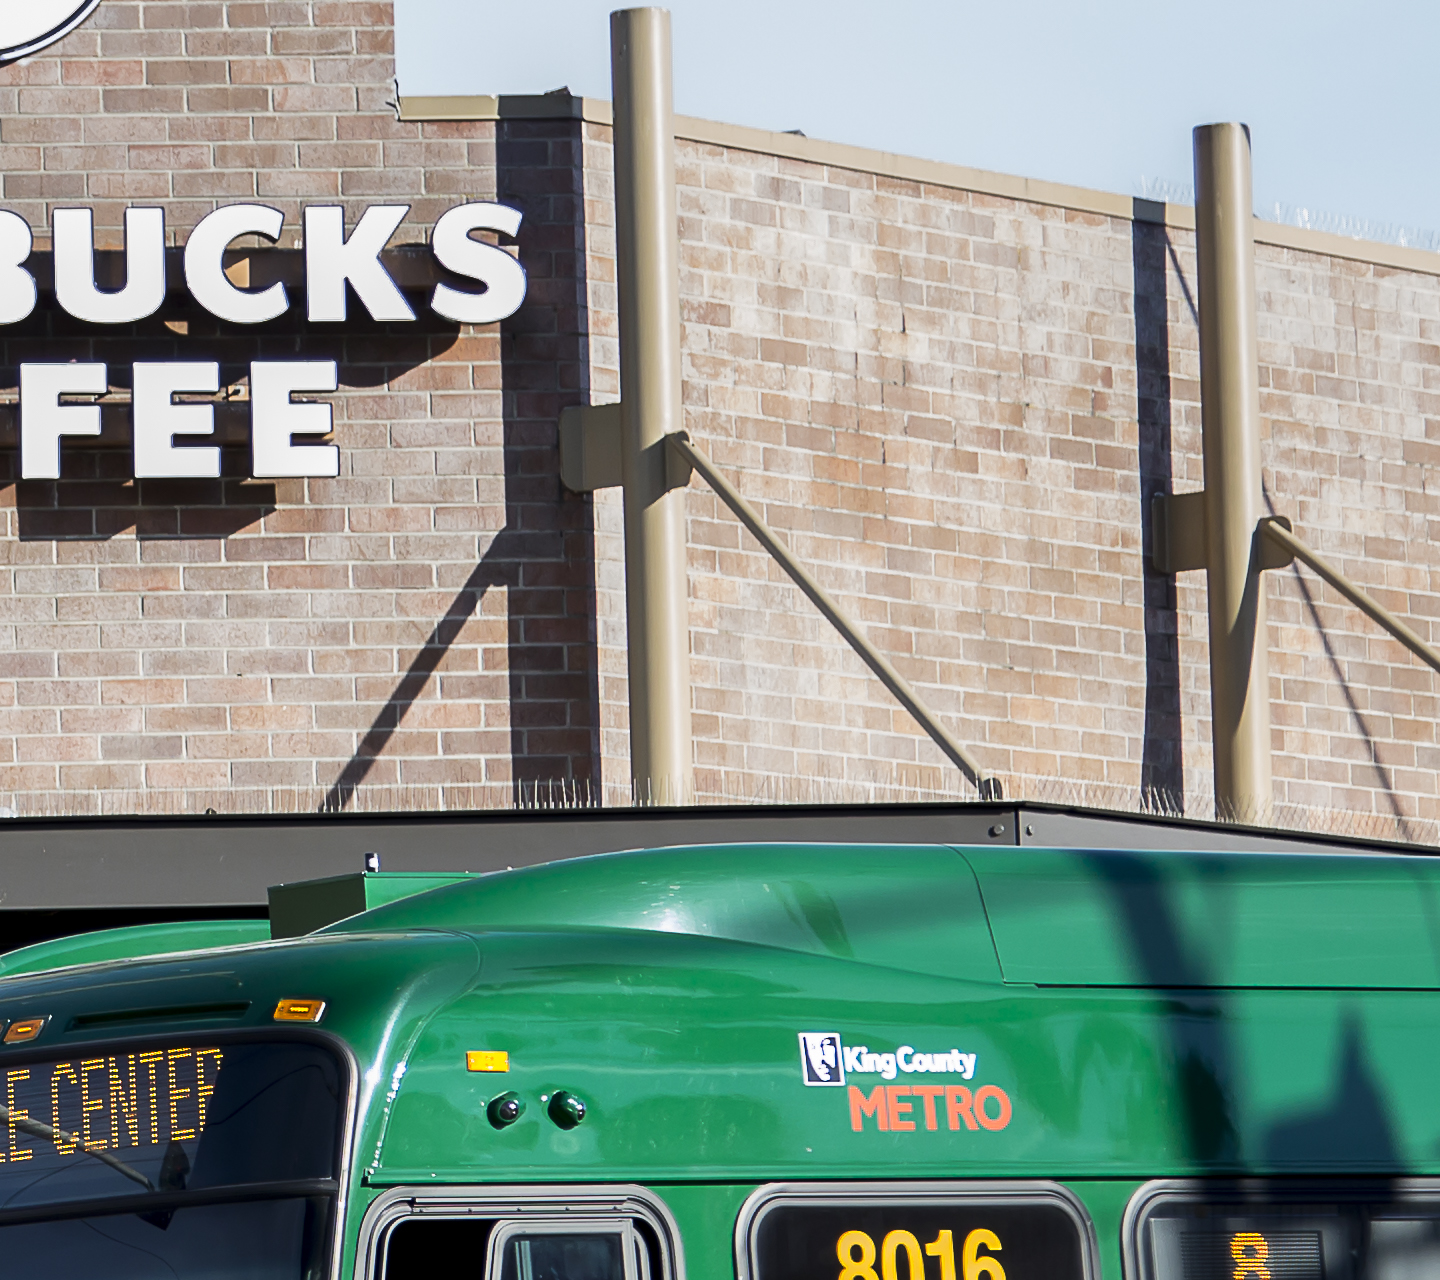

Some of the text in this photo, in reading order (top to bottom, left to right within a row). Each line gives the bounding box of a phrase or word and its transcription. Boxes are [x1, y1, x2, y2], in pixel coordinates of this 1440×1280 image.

[842, 1045, 977, 1080] King County
[848, 1084, 1013, 1132] METRO
